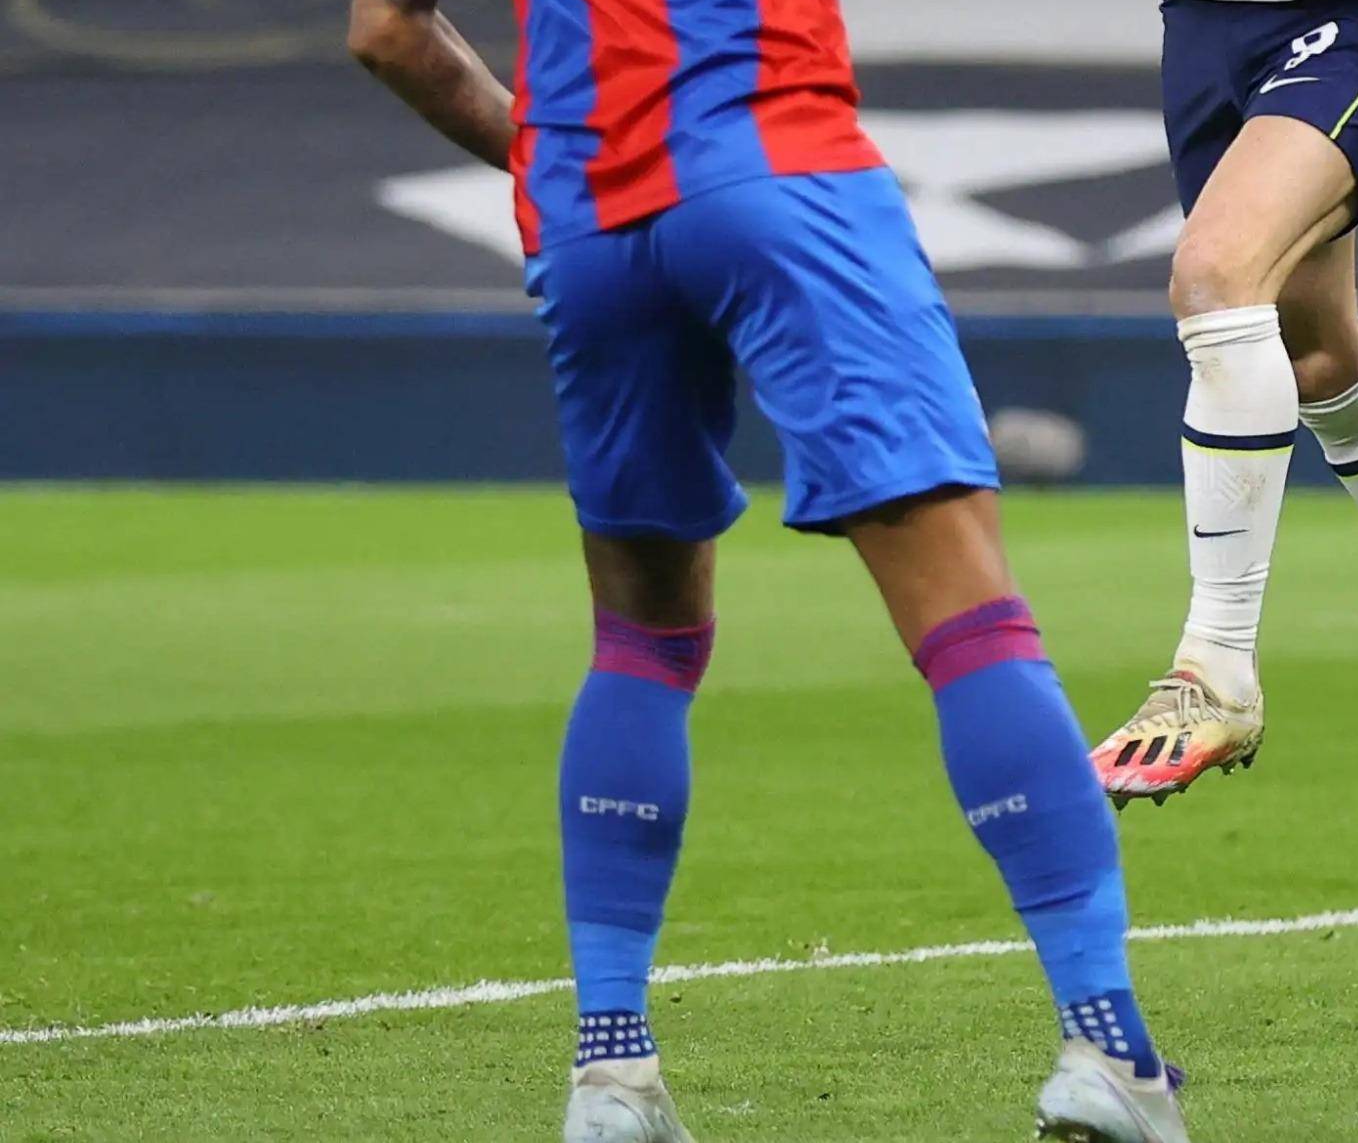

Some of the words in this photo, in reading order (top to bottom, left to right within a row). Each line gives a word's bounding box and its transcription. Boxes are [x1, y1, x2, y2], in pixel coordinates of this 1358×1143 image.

[1284, 21, 1339, 71] 9
[579, 794, 660, 821] CPFC
[967, 793, 1028, 827] CPFC
